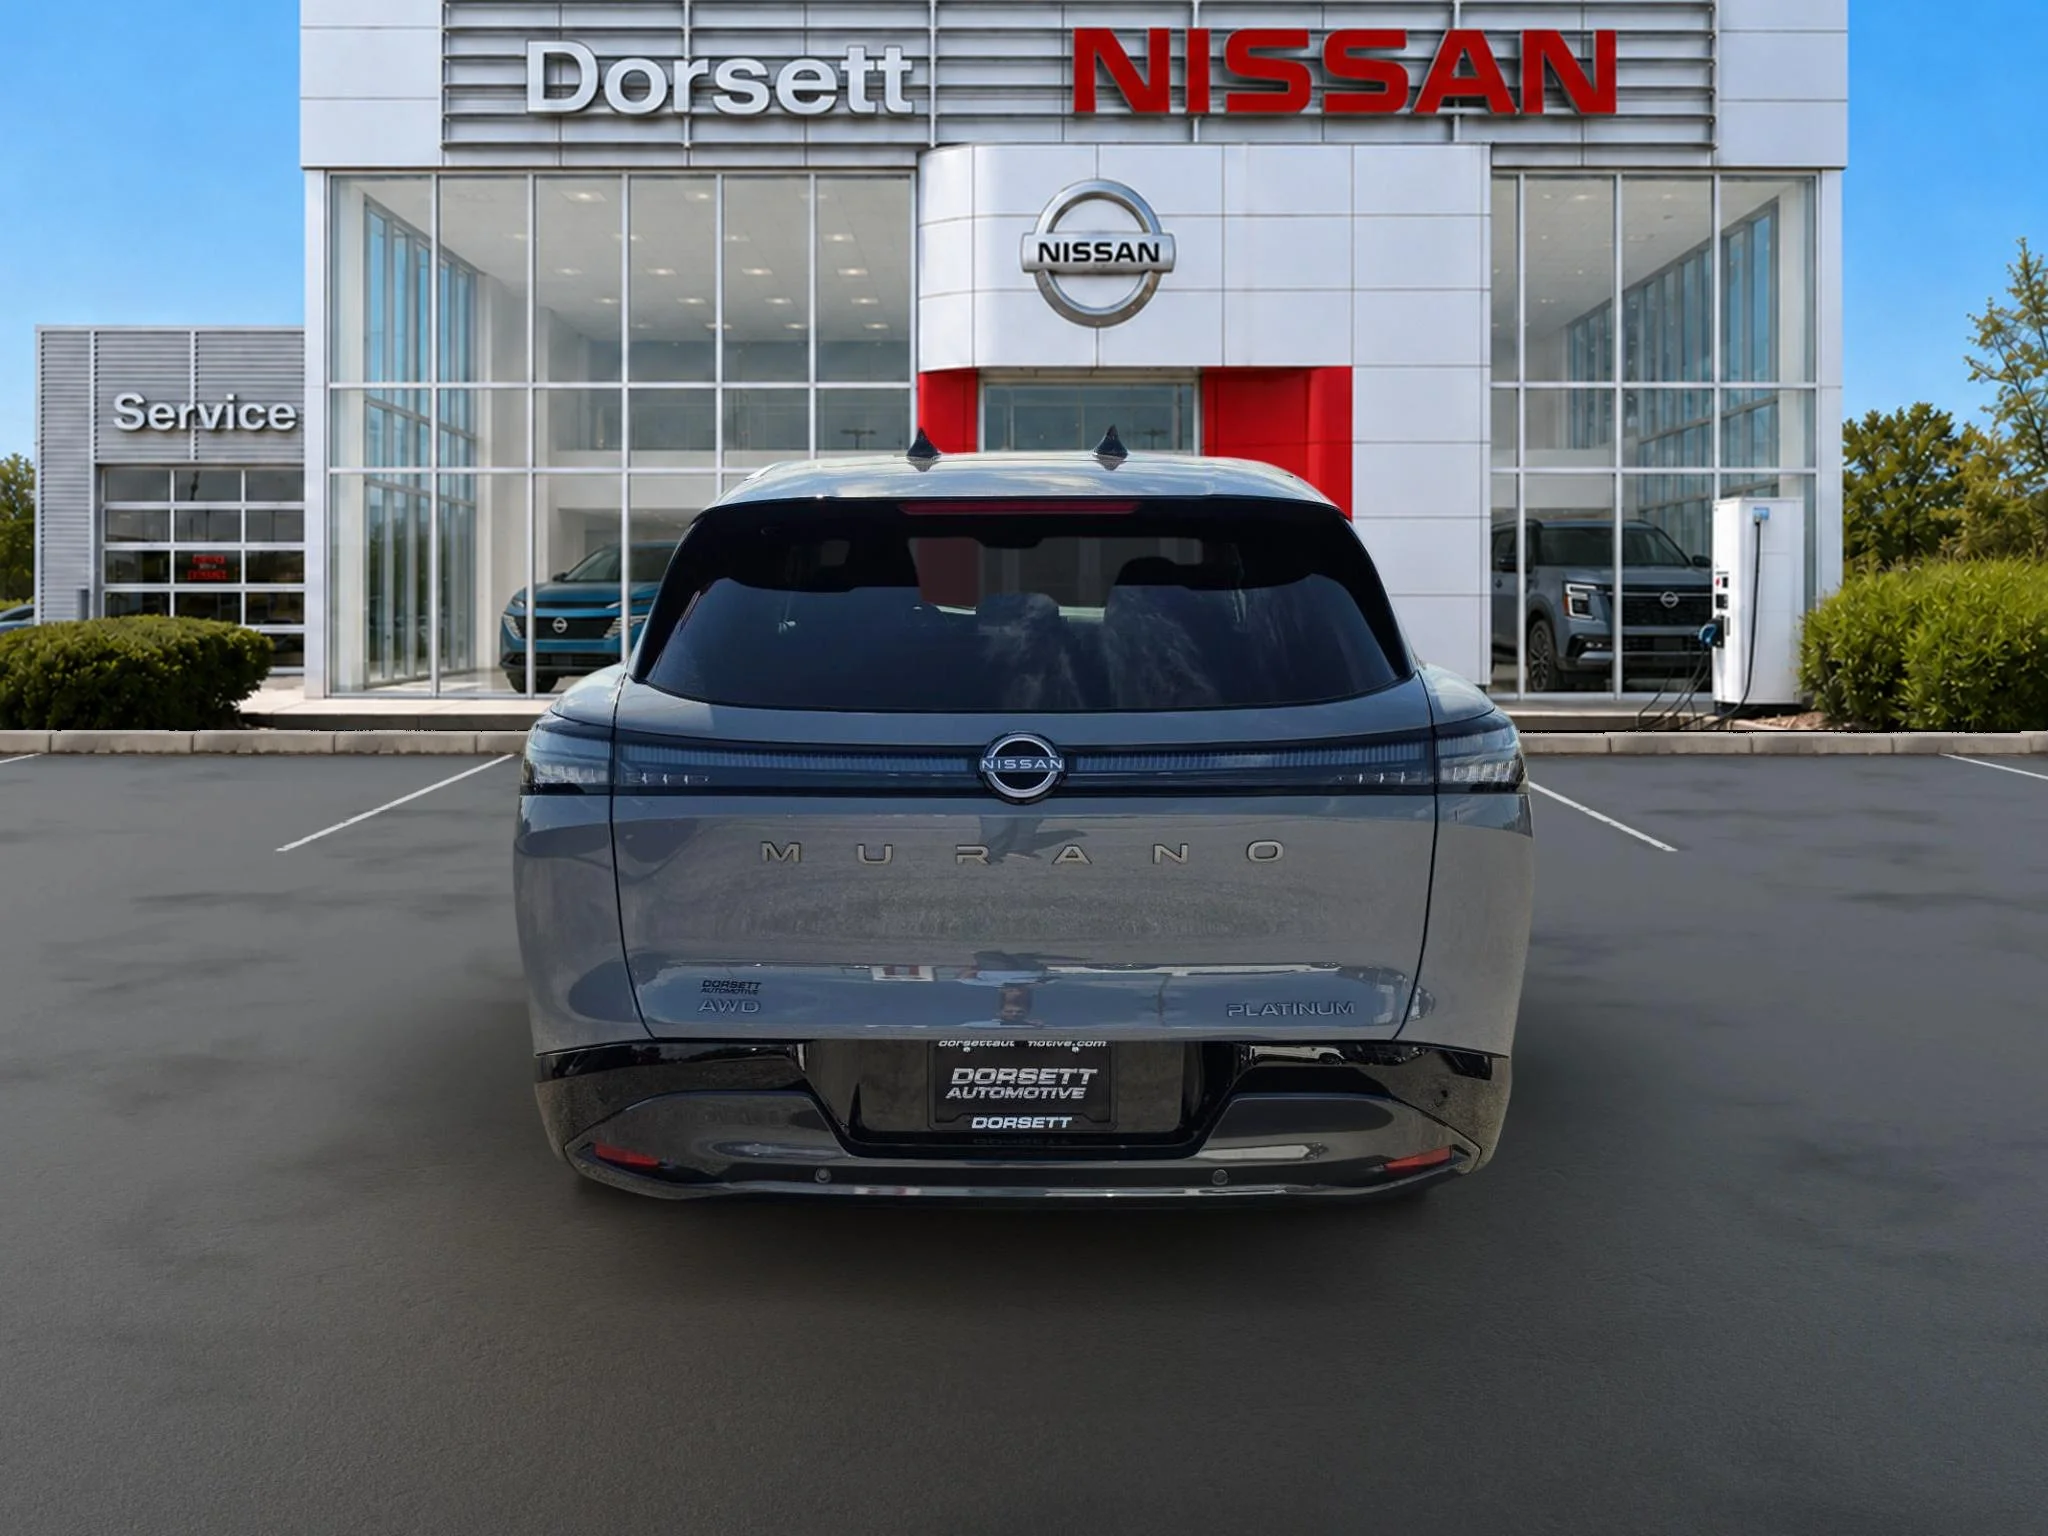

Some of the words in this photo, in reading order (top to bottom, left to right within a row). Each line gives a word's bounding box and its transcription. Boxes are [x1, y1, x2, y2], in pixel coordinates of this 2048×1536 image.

[526, 40, 914, 116] Dorsett
[1073, 27, 1617, 116] NISSAN
[1038, 239, 1162, 266] NISSAN
[113, 393, 298, 432] Service
[981, 758, 1063, 770] NISSAN
[760, 840, 1285, 866] MURANO
[702, 979, 762, 989] DORSETT
[698, 999, 761, 1013] AWD
[1226, 1001, 1355, 1018] PLATINUM
[952, 1067, 1098, 1085] DORSETT
[946, 1086, 1087, 1099] AUTOMOTIVE
[971, 1116, 1073, 1129] DORSETT
